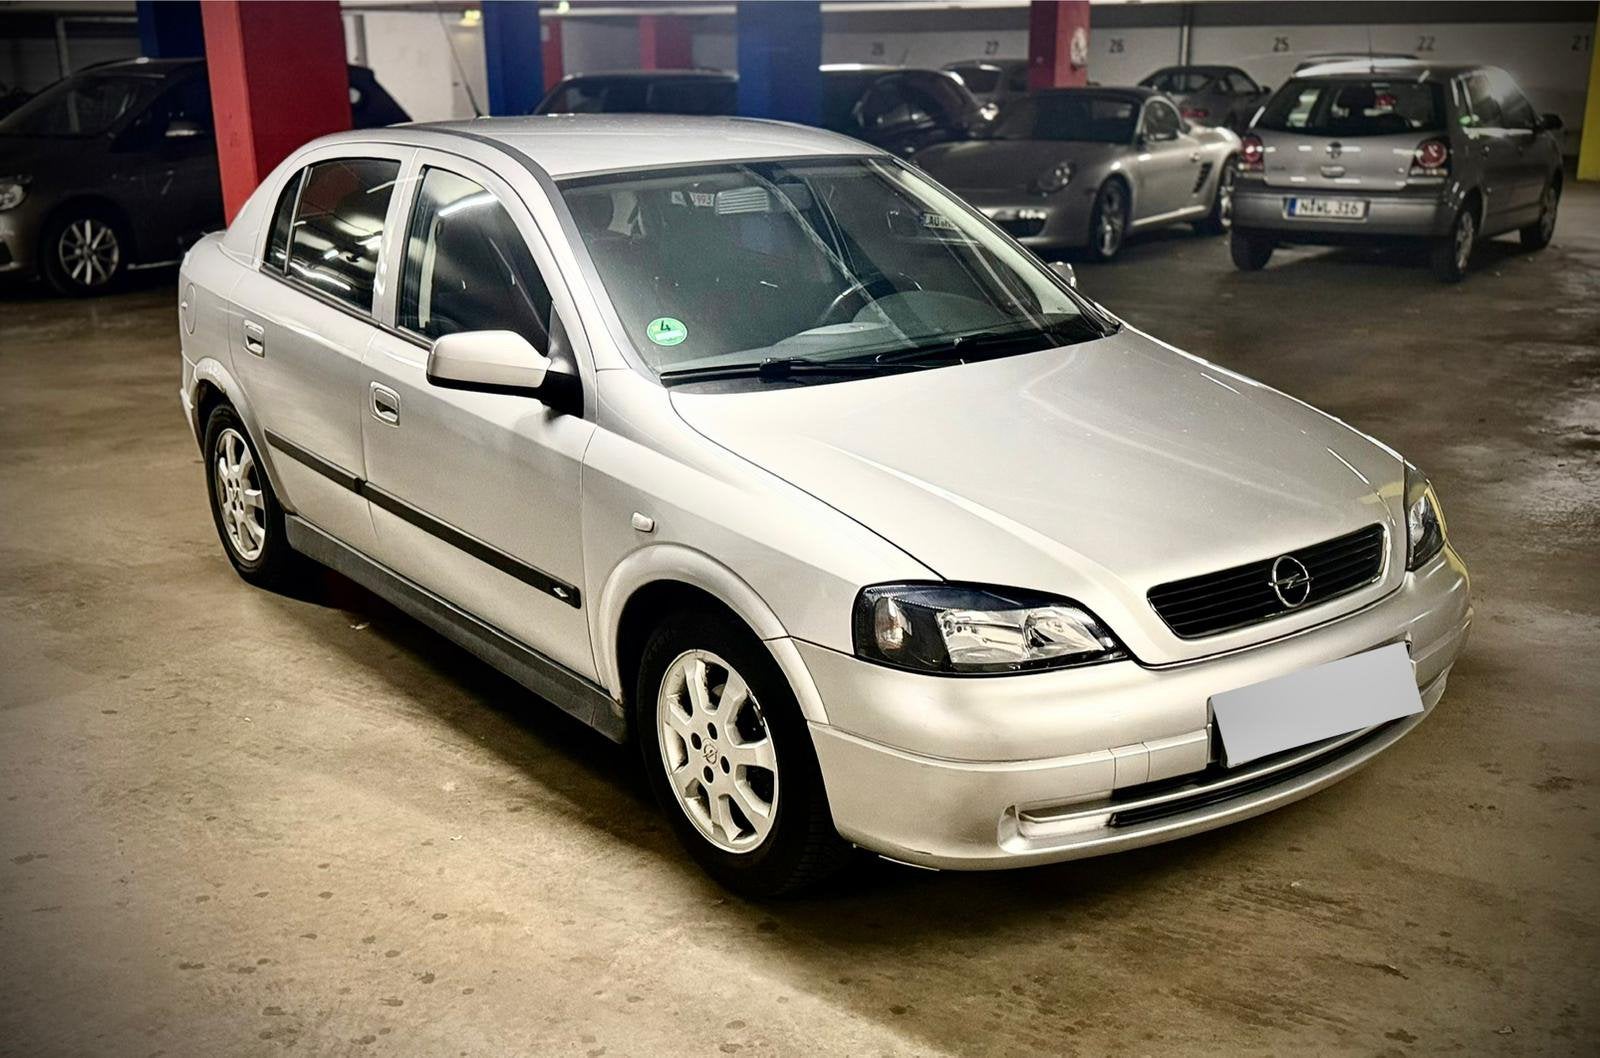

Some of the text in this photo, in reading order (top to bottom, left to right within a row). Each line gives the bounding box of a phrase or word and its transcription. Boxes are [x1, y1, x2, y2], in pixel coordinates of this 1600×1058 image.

[985, 41, 999, 55] 27
[1109, 38, 1124, 53] 26
[1273, 36, 1289, 52] 25
[1417, 36, 1435, 51] 22
[1572, 34, 1590, 51] 21
[660, 320, 671, 331] 4
